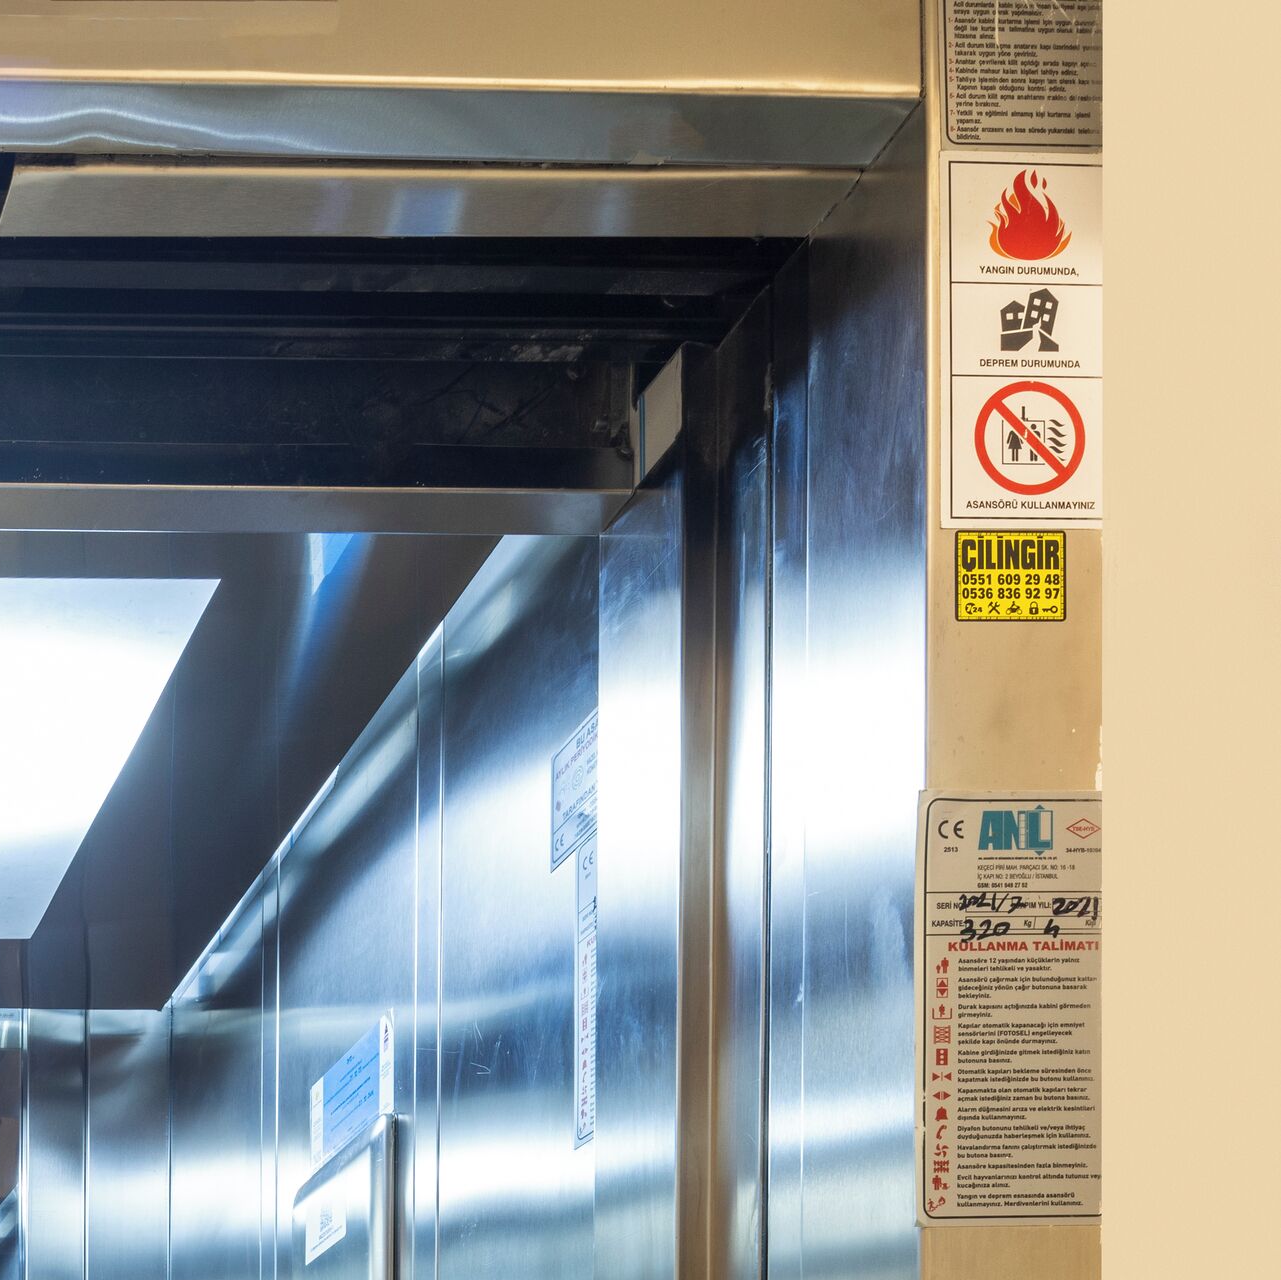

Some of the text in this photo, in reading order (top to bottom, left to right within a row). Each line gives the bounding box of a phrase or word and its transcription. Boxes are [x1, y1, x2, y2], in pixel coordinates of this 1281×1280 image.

[979, 265, 1079, 277] YANGIN DURUMUNDA,
[979, 358, 1081, 368] DEPREM DURUMUNDA
[966, 498, 1095, 510] ASANSÖRÜ KULLANMAYINIZ
[961, 536, 1060, 572] ÇİLİNGİR
[962, 573, 1060, 585] 0551 609 29 48
[962, 587, 1060, 599] 0536 836 92 97
[576, 734, 585, 749] BU
[938, 819, 965, 839] CE
[936, 901, 952, 910] SERİ
[1023, 919, 1032, 928] Kg
[947, 938, 1099, 952] KULLANMA TALİMATI
